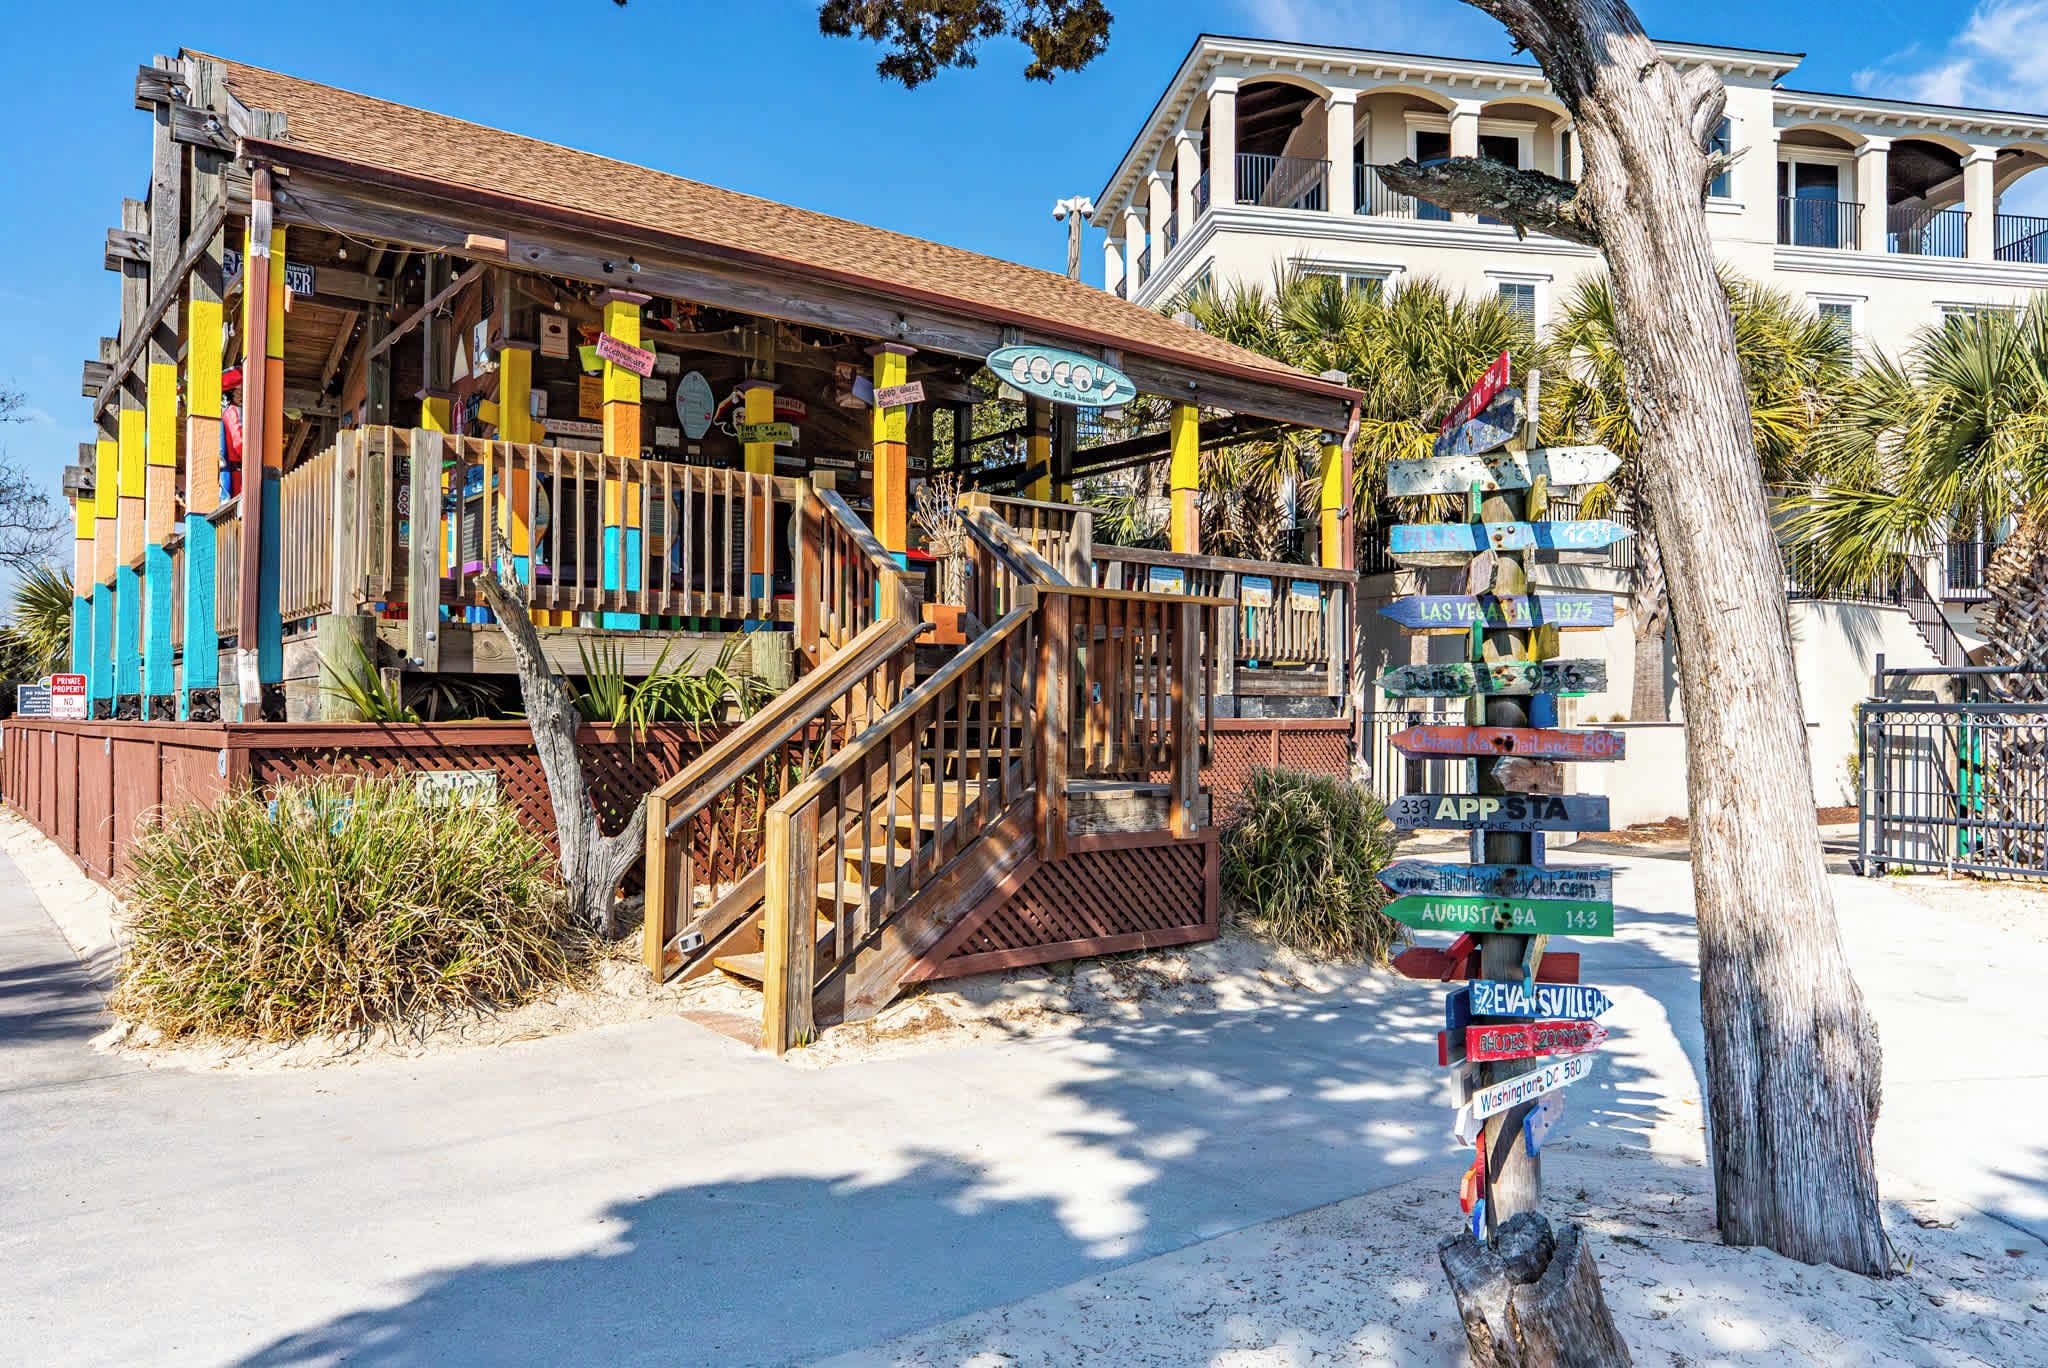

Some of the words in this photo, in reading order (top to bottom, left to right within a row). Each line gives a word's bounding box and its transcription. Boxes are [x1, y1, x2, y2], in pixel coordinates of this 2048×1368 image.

[284, 269, 311, 295] EER
[1420, 602, 1452, 621] LAS
[1455, 602, 1508, 622] VEGAS
[1517, 602, 1541, 621] NV
[1555, 601, 1593, 621] 1975
[56, 677, 81, 685] PRIVATE
[1524, 664, 1581, 690] 936
[52, 686, 84, 694] PROPERTY
[63, 697, 74, 706] NO
[1400, 799, 1431, 815] 339
[1396, 815, 1429, 827] miles
[1521, 821, 1544, 831] NC
[1421, 902, 1503, 925] AUGUSTA
[1512, 906, 1537, 927] GA
[1565, 910, 1598, 929] 143
[1494, 983, 1594, 1018] EVANSVILLE
[1480, 1078, 1538, 1113] Washington
[1546, 1066, 1560, 1088] DC
[1564, 1058, 1582, 1080] 580
